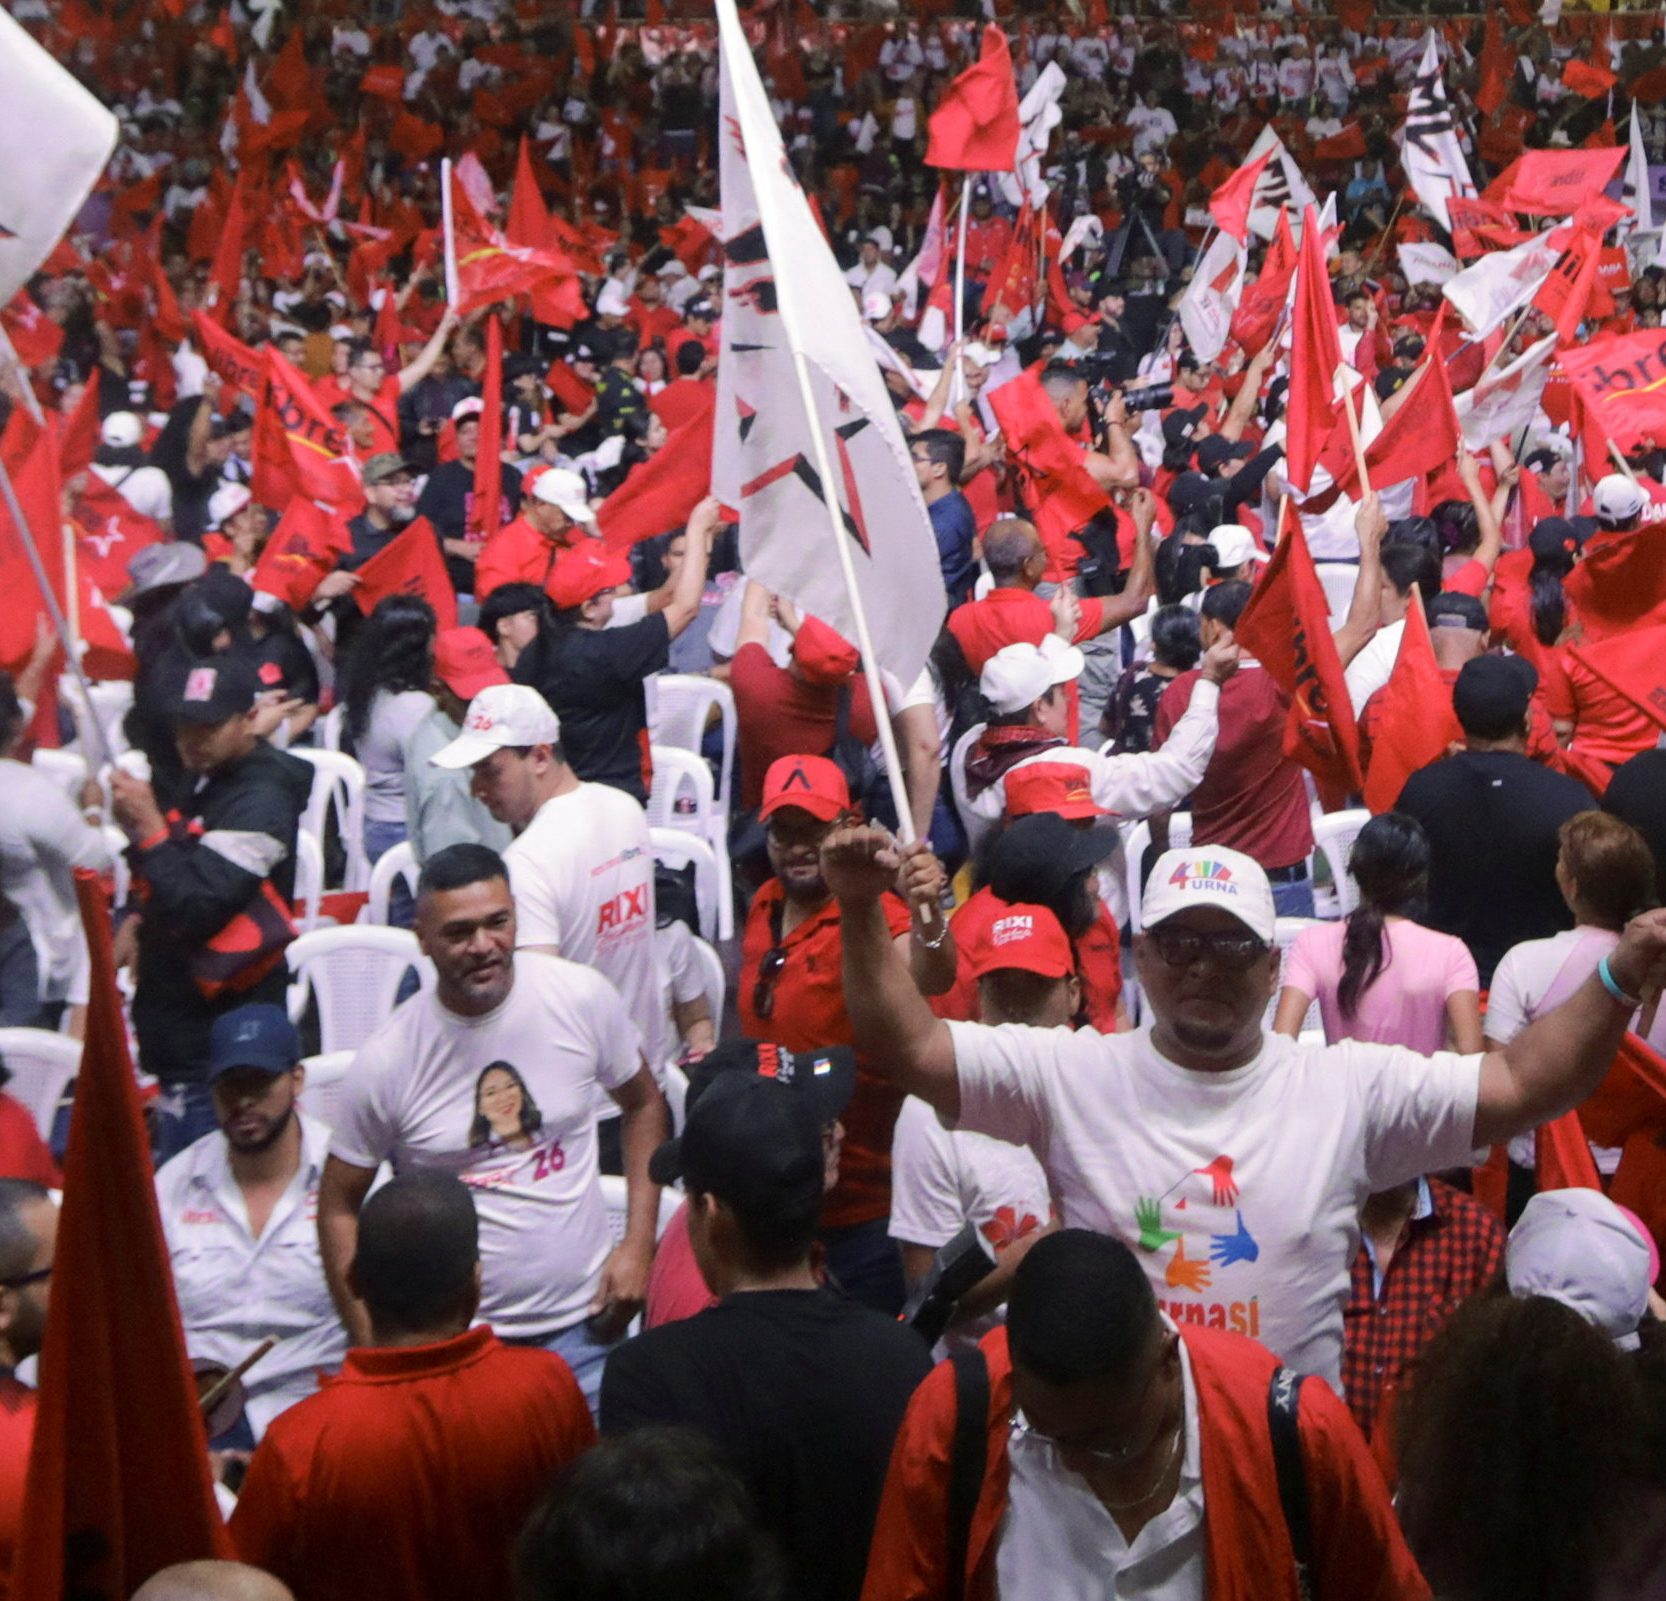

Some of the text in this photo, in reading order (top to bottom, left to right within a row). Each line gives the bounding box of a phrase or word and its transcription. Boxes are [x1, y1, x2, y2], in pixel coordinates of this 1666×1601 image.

[1168, 861, 1239, 897] 4 URNA
[596, 882, 649, 935] RIXI
[992, 915, 1034, 935] RIXI
[532, 1140, 565, 1182] 26
